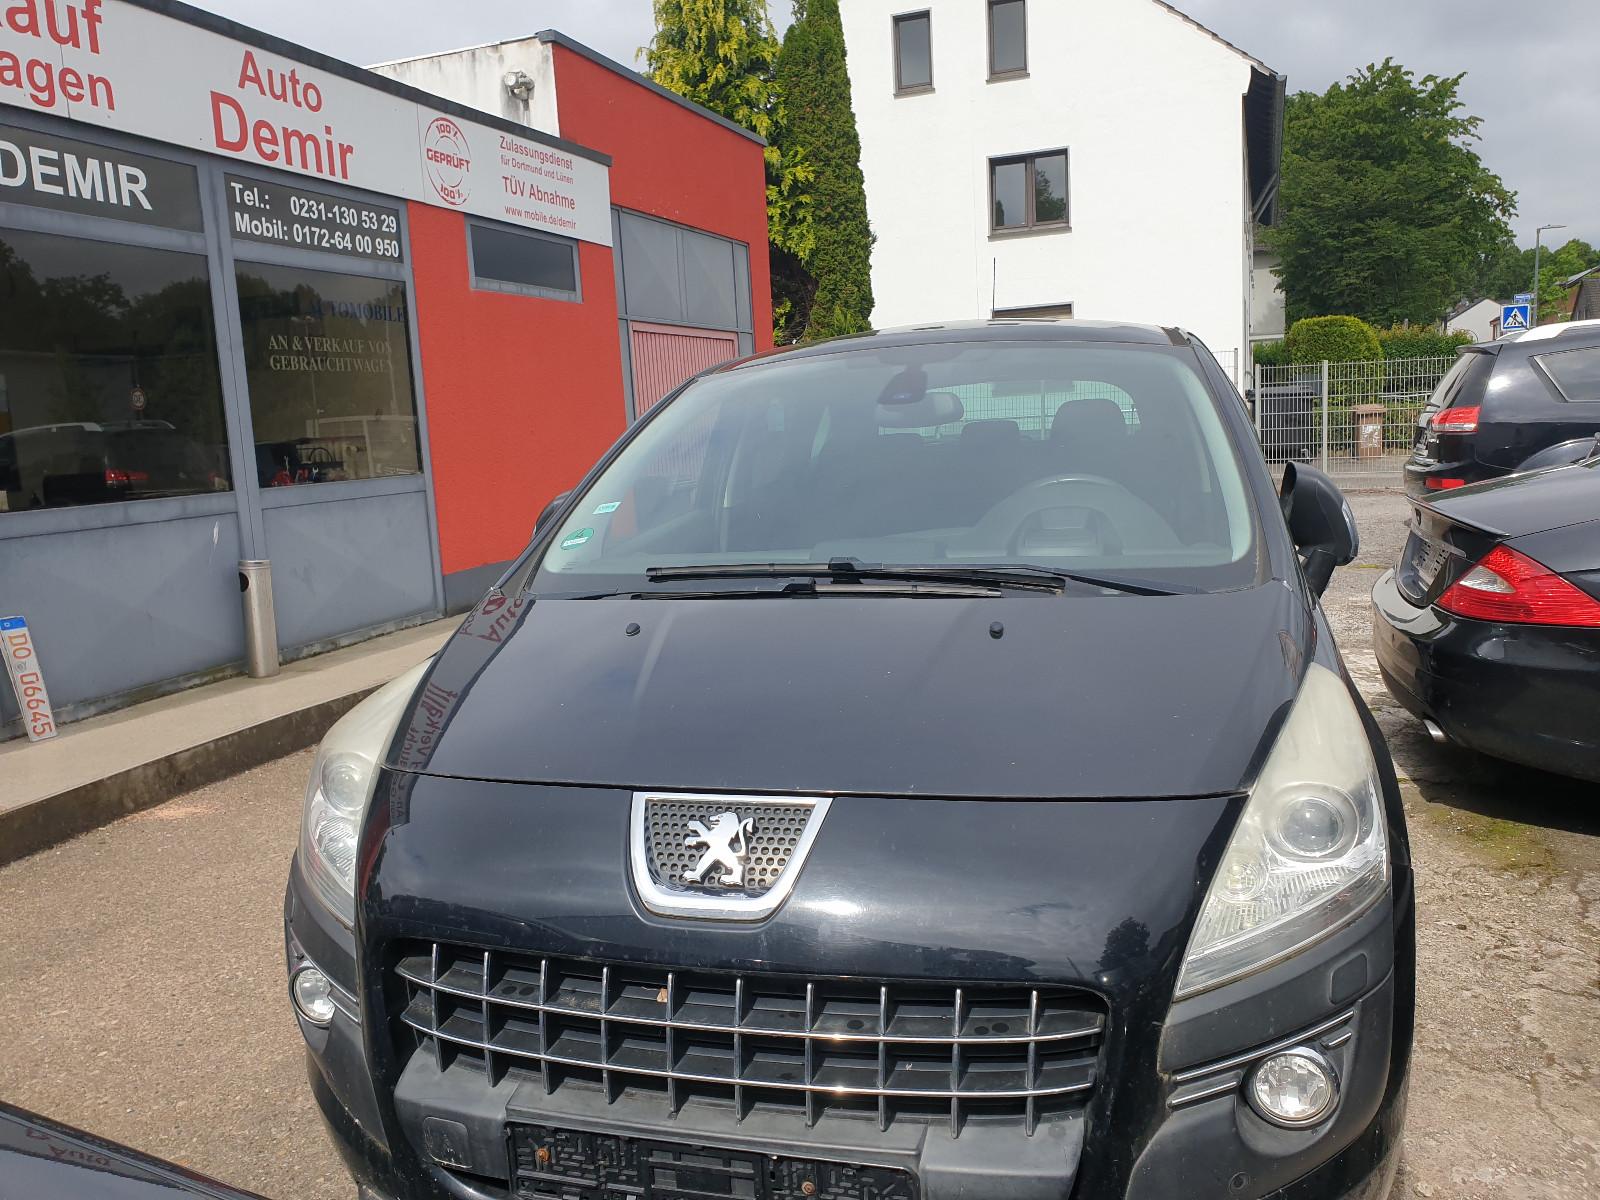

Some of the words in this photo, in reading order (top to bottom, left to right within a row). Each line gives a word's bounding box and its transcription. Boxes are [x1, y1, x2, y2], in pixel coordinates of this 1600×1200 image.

[0, 0, 102, 55] auf
[238, 50, 322, 112] Auto
[210, 90, 354, 180] Demir
[499, 135, 573, 171] Zulassungsdienst
[0, 140, 153, 210] DEMIR
[426, 147, 471, 173] GEPRÜFT
[501, 154, 510, 166] für
[511, 157, 543, 176] Dortmund
[543, 169, 555, 179] und
[230, 181, 270, 210] Tel.:
[290, 195, 358, 227] 0231-130
[361, 210, 378, 230] 53
[380, 214, 397, 233] 29
[502, 174, 526, 197] TÜV
[529, 183, 576, 210] Abnahme
[234, 211, 289, 241] Mobil:
[293, 223, 353, 251] 0172-64
[355, 234, 373, 254] 00
[375, 237, 400, 258] 950
[268, 334, 289, 351] AN
[292, 335, 304, 351] &
[304, 336, 366, 354] VERKAUF
[8, 632, 32, 660] DO
